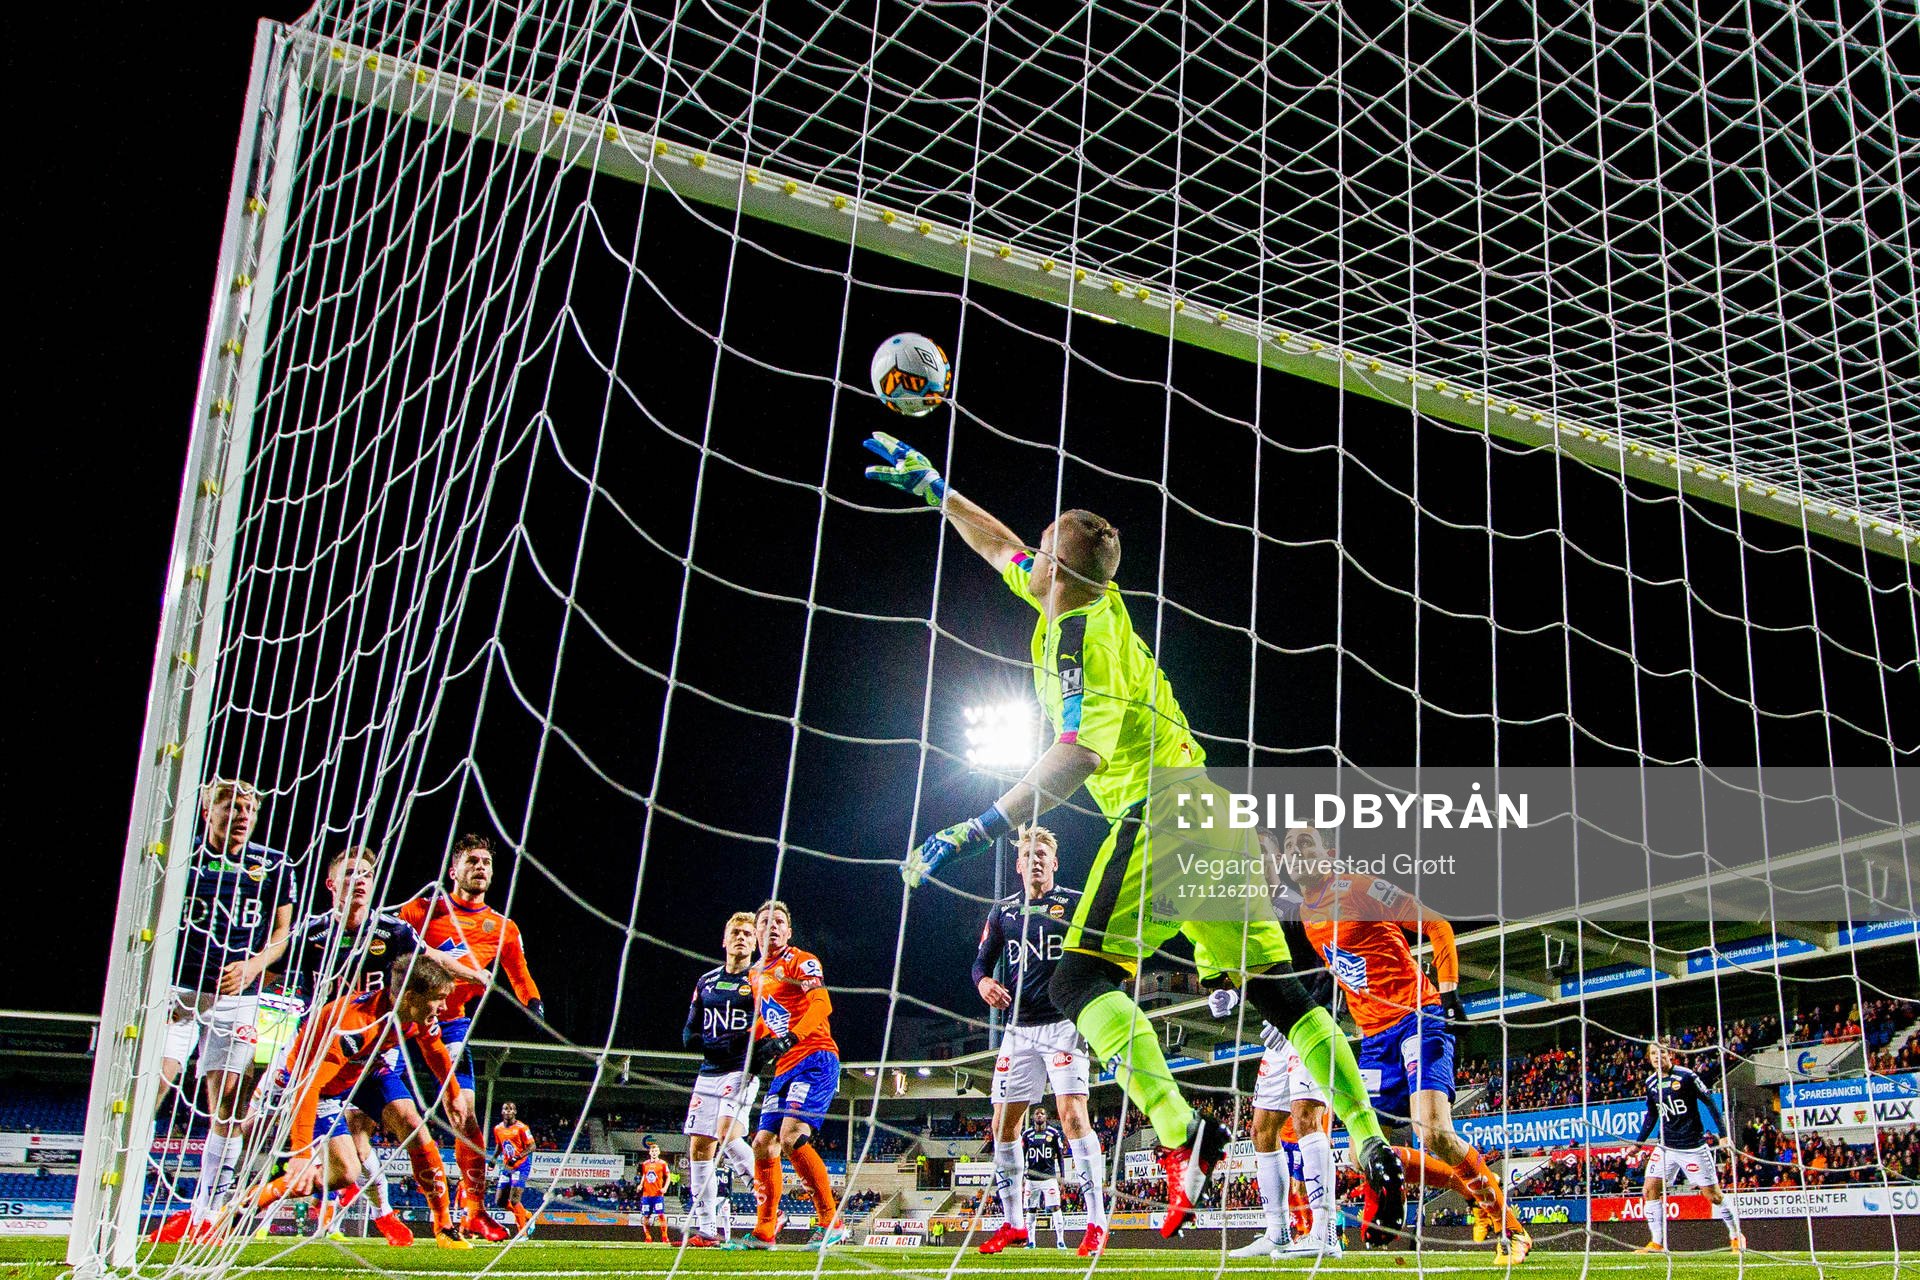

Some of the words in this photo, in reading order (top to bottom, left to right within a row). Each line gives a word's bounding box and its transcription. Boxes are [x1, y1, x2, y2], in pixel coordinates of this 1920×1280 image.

[183, 889, 263, 932] DNB
[1008, 926, 1065, 972] DNB
[704, 1000, 749, 1038] DNB
[1799, 1085, 1862, 1101] SPAREBANKEN
[1803, 1106, 1843, 1128] MAX
[1873, 1100, 1915, 1122] MAX
[1462, 1117, 1584, 1146] SPAREBANKEN
[1028, 1144, 1052, 1163] DNB
[902, 1221, 924, 1229] JULA
[868, 1236, 889, 1246] ACEL
[895, 1236, 917, 1246] ACEL
